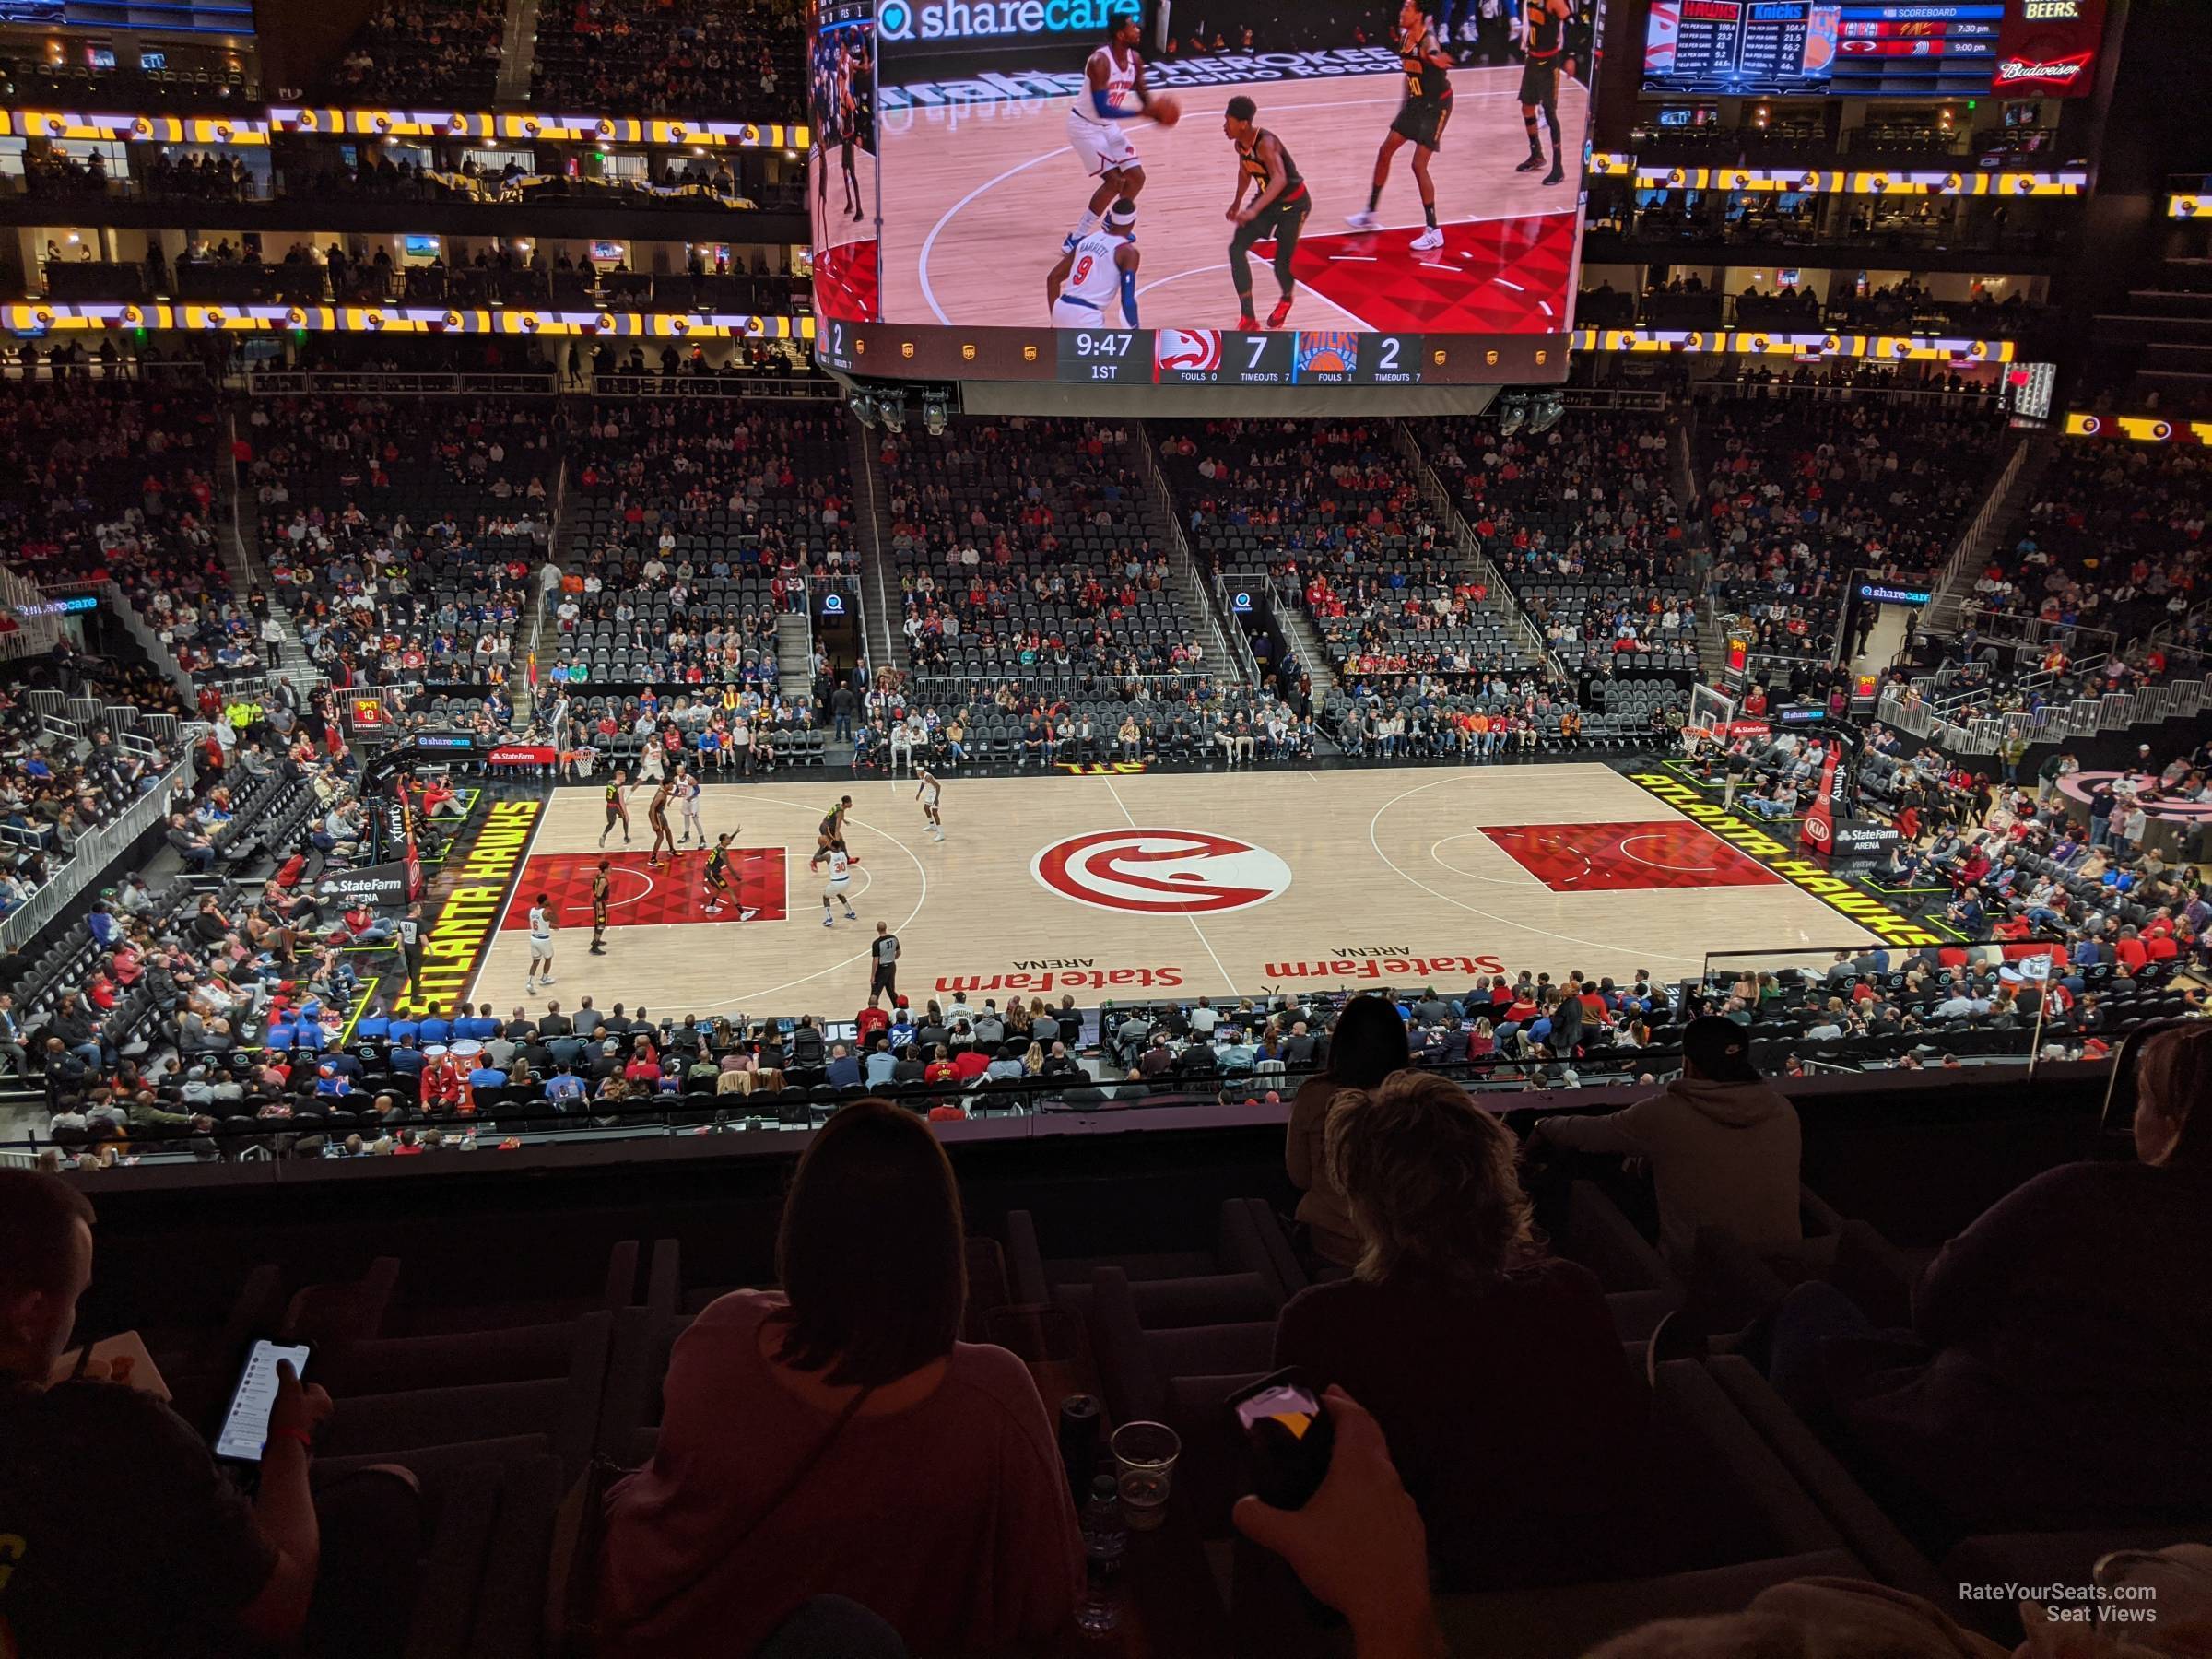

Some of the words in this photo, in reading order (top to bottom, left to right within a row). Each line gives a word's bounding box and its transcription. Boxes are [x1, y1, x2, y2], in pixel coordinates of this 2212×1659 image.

[1684, 1, 1737, 18] HAWKS
[1755, 5, 1803, 19] Knicks
[1899, 8, 1957, 17] SCOREBOARD
[2026, 2, 2078, 18] BEERS.
[1957, 25, 1975, 33] 7:30
[1976, 26, 1989, 34] pm
[1955, 43, 1972, 52] 9:00
[1973, 44, 1986, 53] pm
[1288, 60, 1403, 76] Resor
[2001, 63, 2080, 78] Budweiser
[1073, 256, 1093, 285] 9
[834, 324, 842, 355] 2
[1077, 333, 1133, 357] 9:47
[1246, 336, 1268, 369] 7
[1380, 337, 1401, 369] 2
[1091, 365, 1118, 379] 1ST
[1181, 372, 1206, 381] FOULS
[1211, 372, 1218, 381] 0
[1241, 373, 1278, 382] TIMEOUTS
[1318, 373, 1342, 382] FOULS
[1347, 373, 1352, 382] 1
[1375, 373, 1410, 382] TIMEOUTS
[1416, 373, 1420, 382] 7
[428, 736, 471, 747] sharecare
[1830, 764, 1847, 802] xfinity
[1630, 773, 1792, 855] ATLANTA
[388, 803, 406, 843] xfinity
[461, 800, 542, 879] HAWKS
[1854, 841, 1880, 850] ARENA
[834, 862, 846, 873] 30
[1331, 946, 1410, 958] ARENA
[1012, 958, 1095, 971] ARENA
